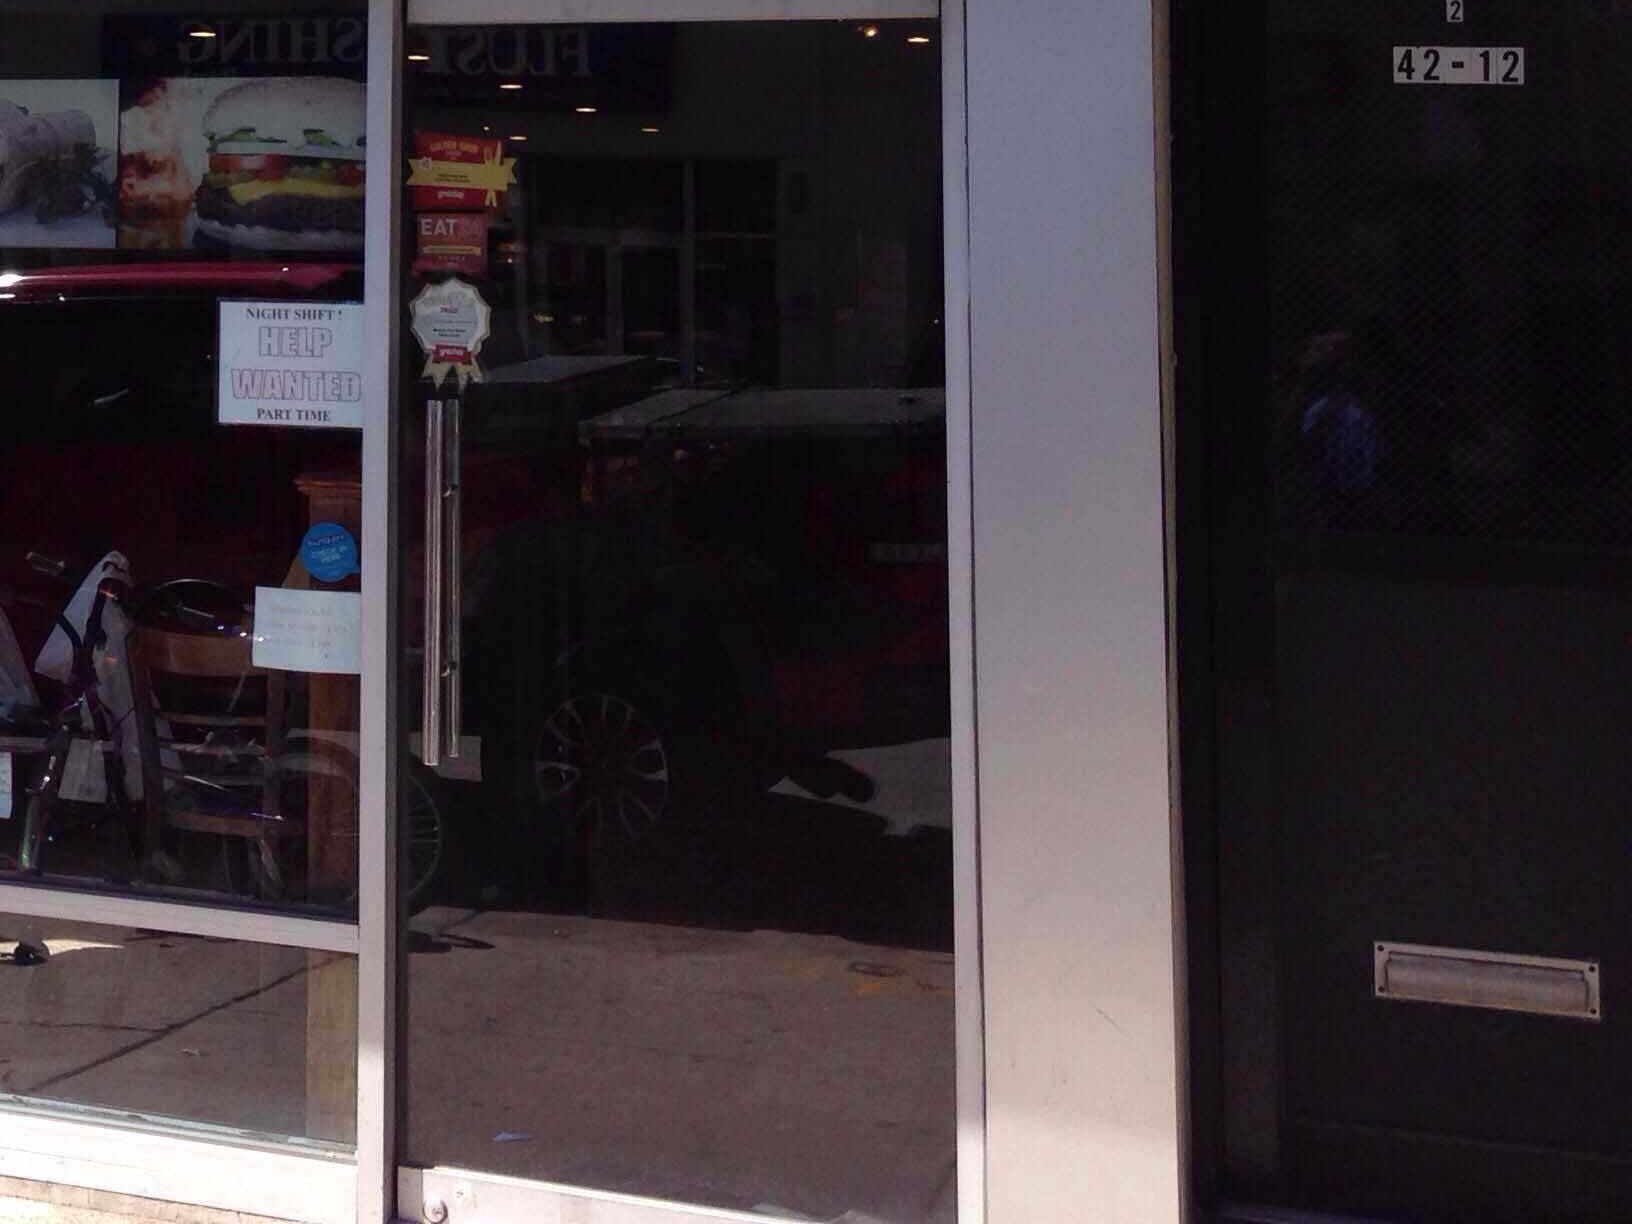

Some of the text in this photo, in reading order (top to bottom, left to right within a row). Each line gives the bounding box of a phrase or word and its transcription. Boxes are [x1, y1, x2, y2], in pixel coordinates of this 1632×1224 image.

[1450, 1, 1461, 21] 2
[1397, 48, 1520, 83] 42-12
[246, 307, 291, 321] NIGHT
[258, 325, 334, 358] HELP
[230, 368, 362, 402] WANTED
[257, 407, 331, 422] PART TIME
